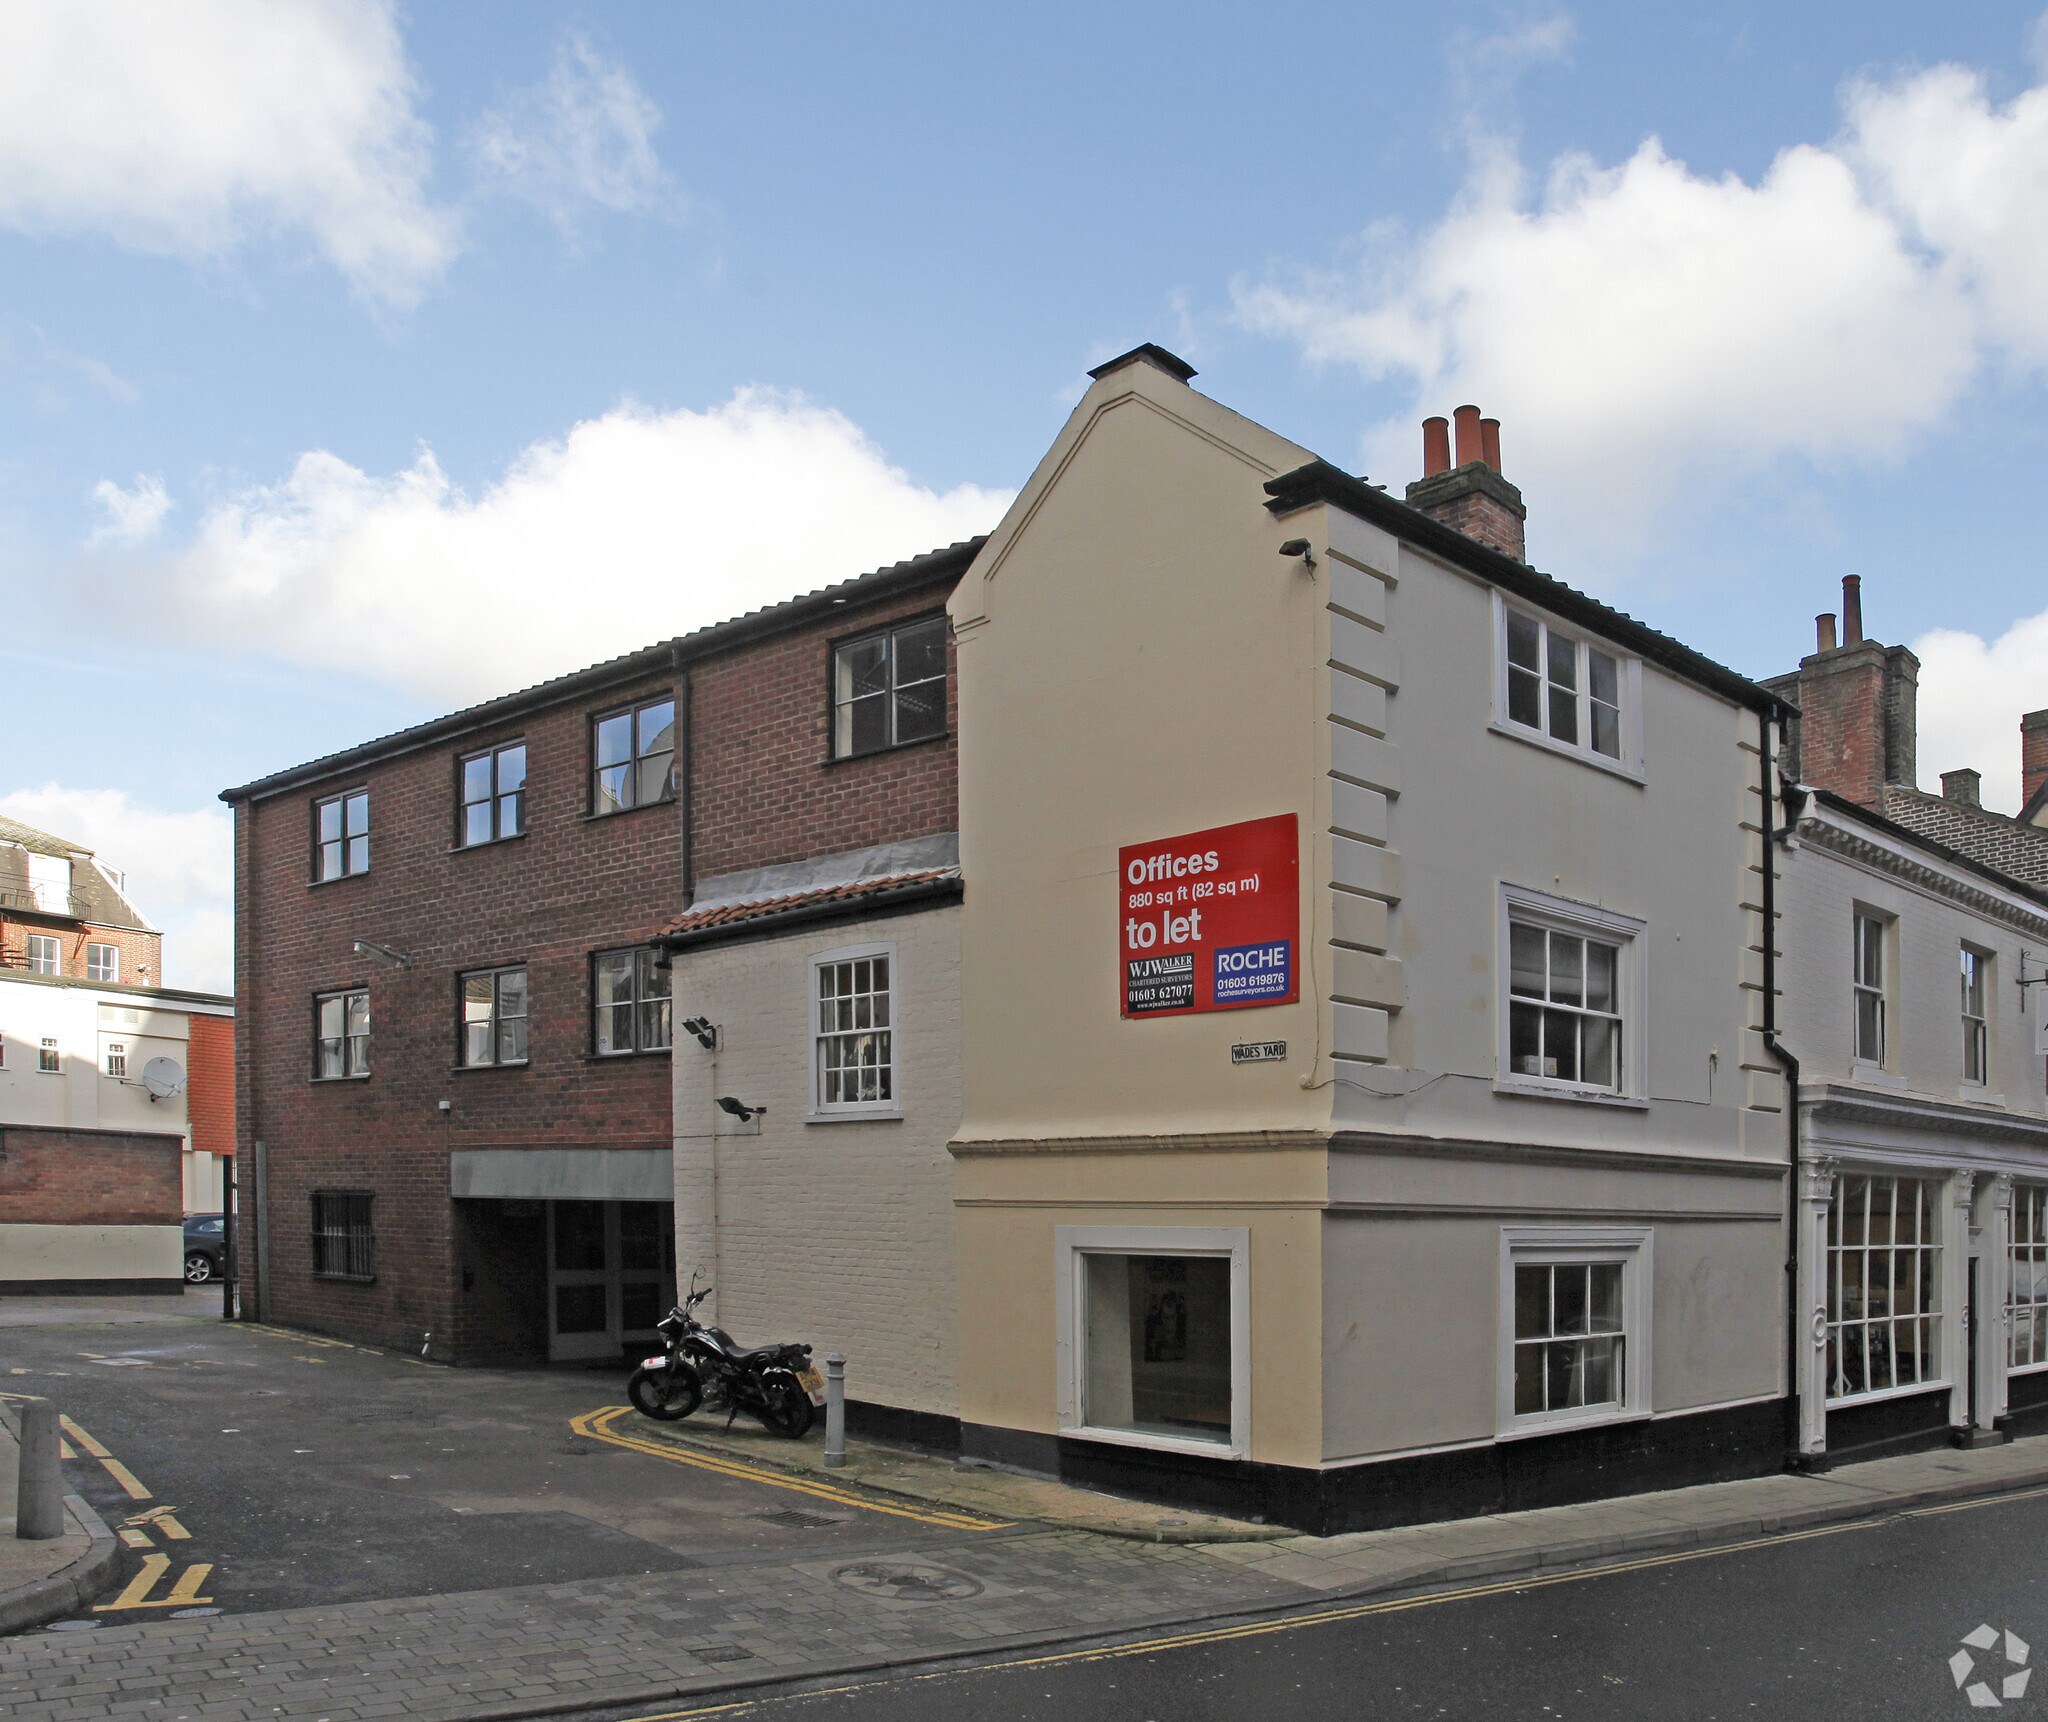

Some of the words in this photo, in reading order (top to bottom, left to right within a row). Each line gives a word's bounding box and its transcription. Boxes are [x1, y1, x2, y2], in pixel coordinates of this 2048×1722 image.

[1127, 850, 1219, 885] Offices
[1128, 891, 1153, 909] 880
[1156, 890, 1173, 906] sq
[1177, 886, 1188, 901] ft
[1192, 881, 1214, 902] (82
[1217, 880, 1236, 896] sq
[1240, 873, 1260, 893] m)
[1125, 917, 1157, 950] to
[1163, 907, 1202, 945] let
[1218, 946, 1285, 973] ROCHE
[1128, 977, 1161, 988] CHARTERED
[1160, 973, 1193, 984] SURVEYORS
[1217, 976, 1247, 990] 01603
[1248, 972, 1285, 987] 619876
[1128, 988, 1156, 1003] 01603
[1159, 984, 1193, 999] 627077
[1217, 984, 1285, 998] rochesurveyors.co.uk
[1233, 1045, 1260, 1060] WADES
[1262, 1044, 1284, 1057] YARD
